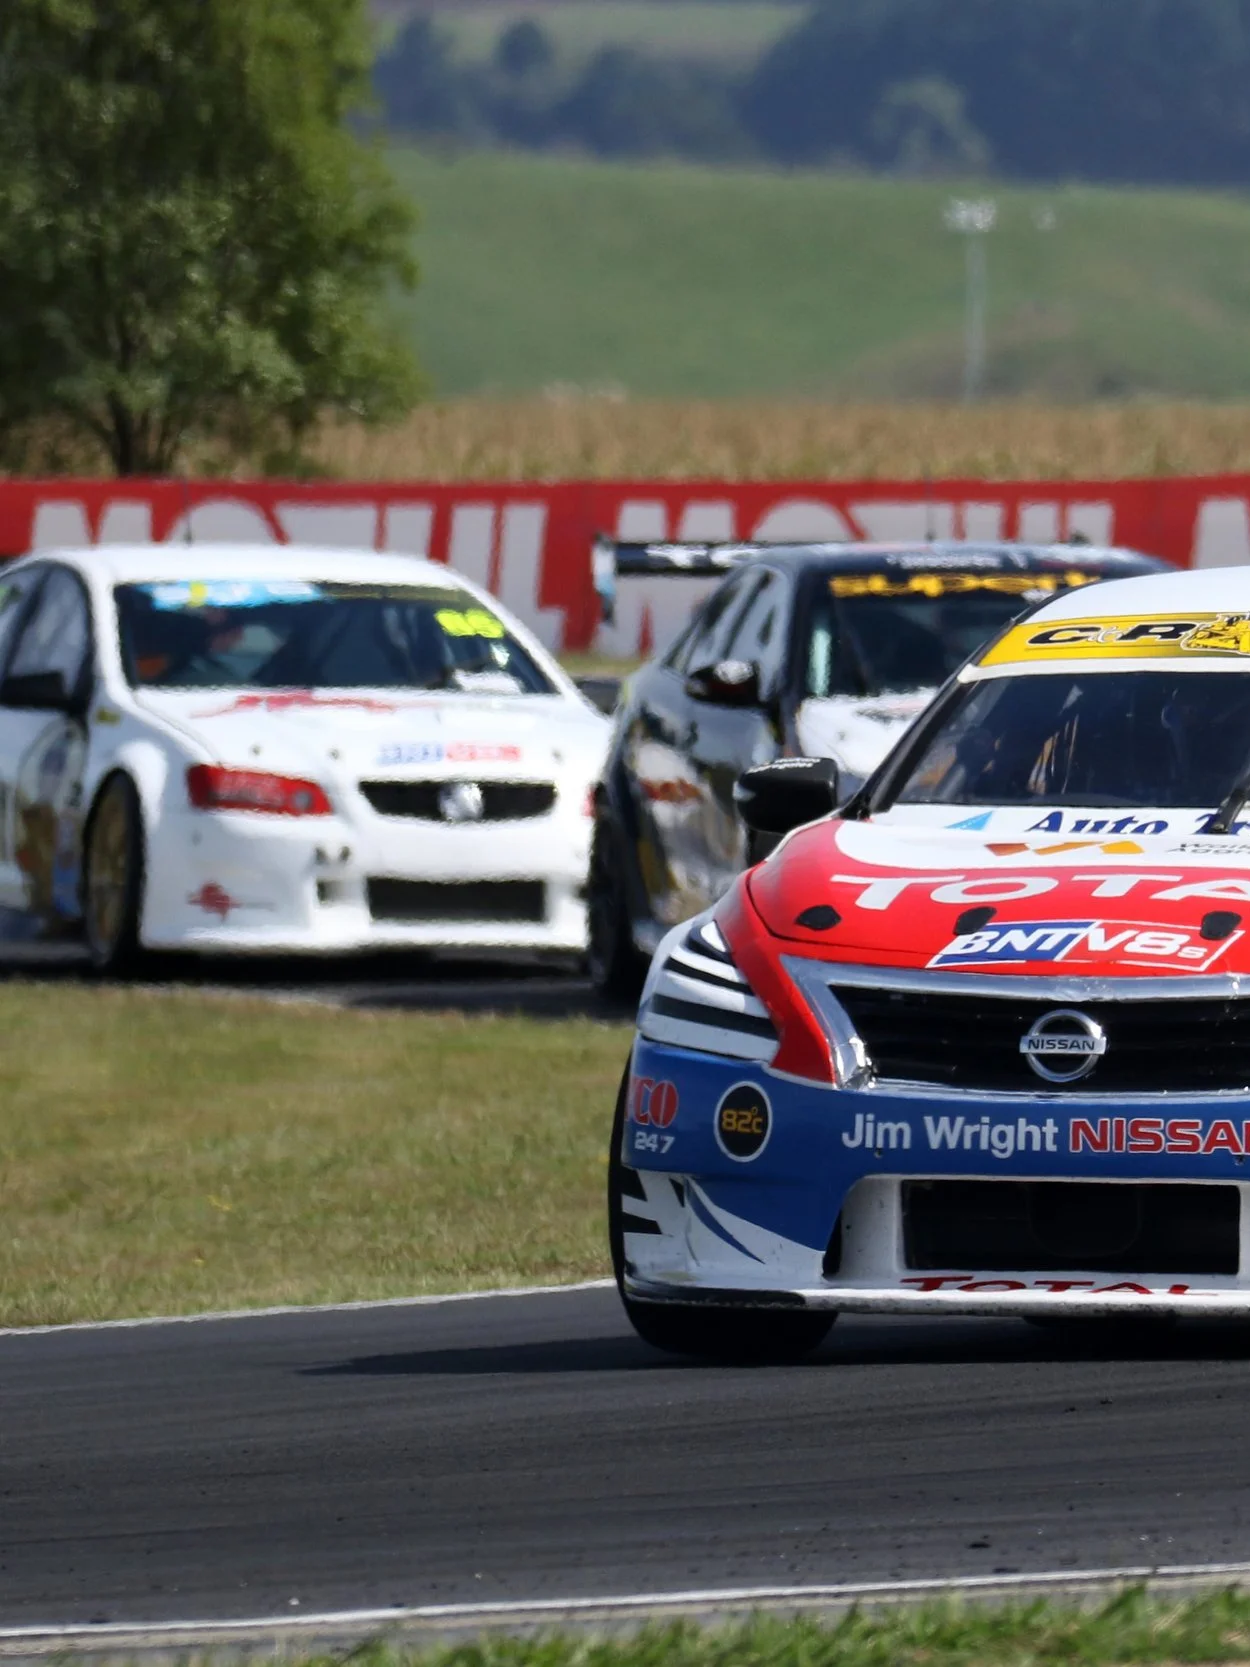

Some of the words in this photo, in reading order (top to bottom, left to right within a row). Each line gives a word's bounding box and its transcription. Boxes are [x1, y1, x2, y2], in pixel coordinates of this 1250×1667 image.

[1024, 810, 1169, 835] Auto
[1027, 1038, 1095, 1051] NISSAN
[629, 1075, 680, 1129] CO
[634, 1131, 675, 1154] 247
[841, 1113, 911, 1149] Jim
[923, 1115, 1059, 1158] Wright
[900, 1275, 1218, 1296] TOTAL
